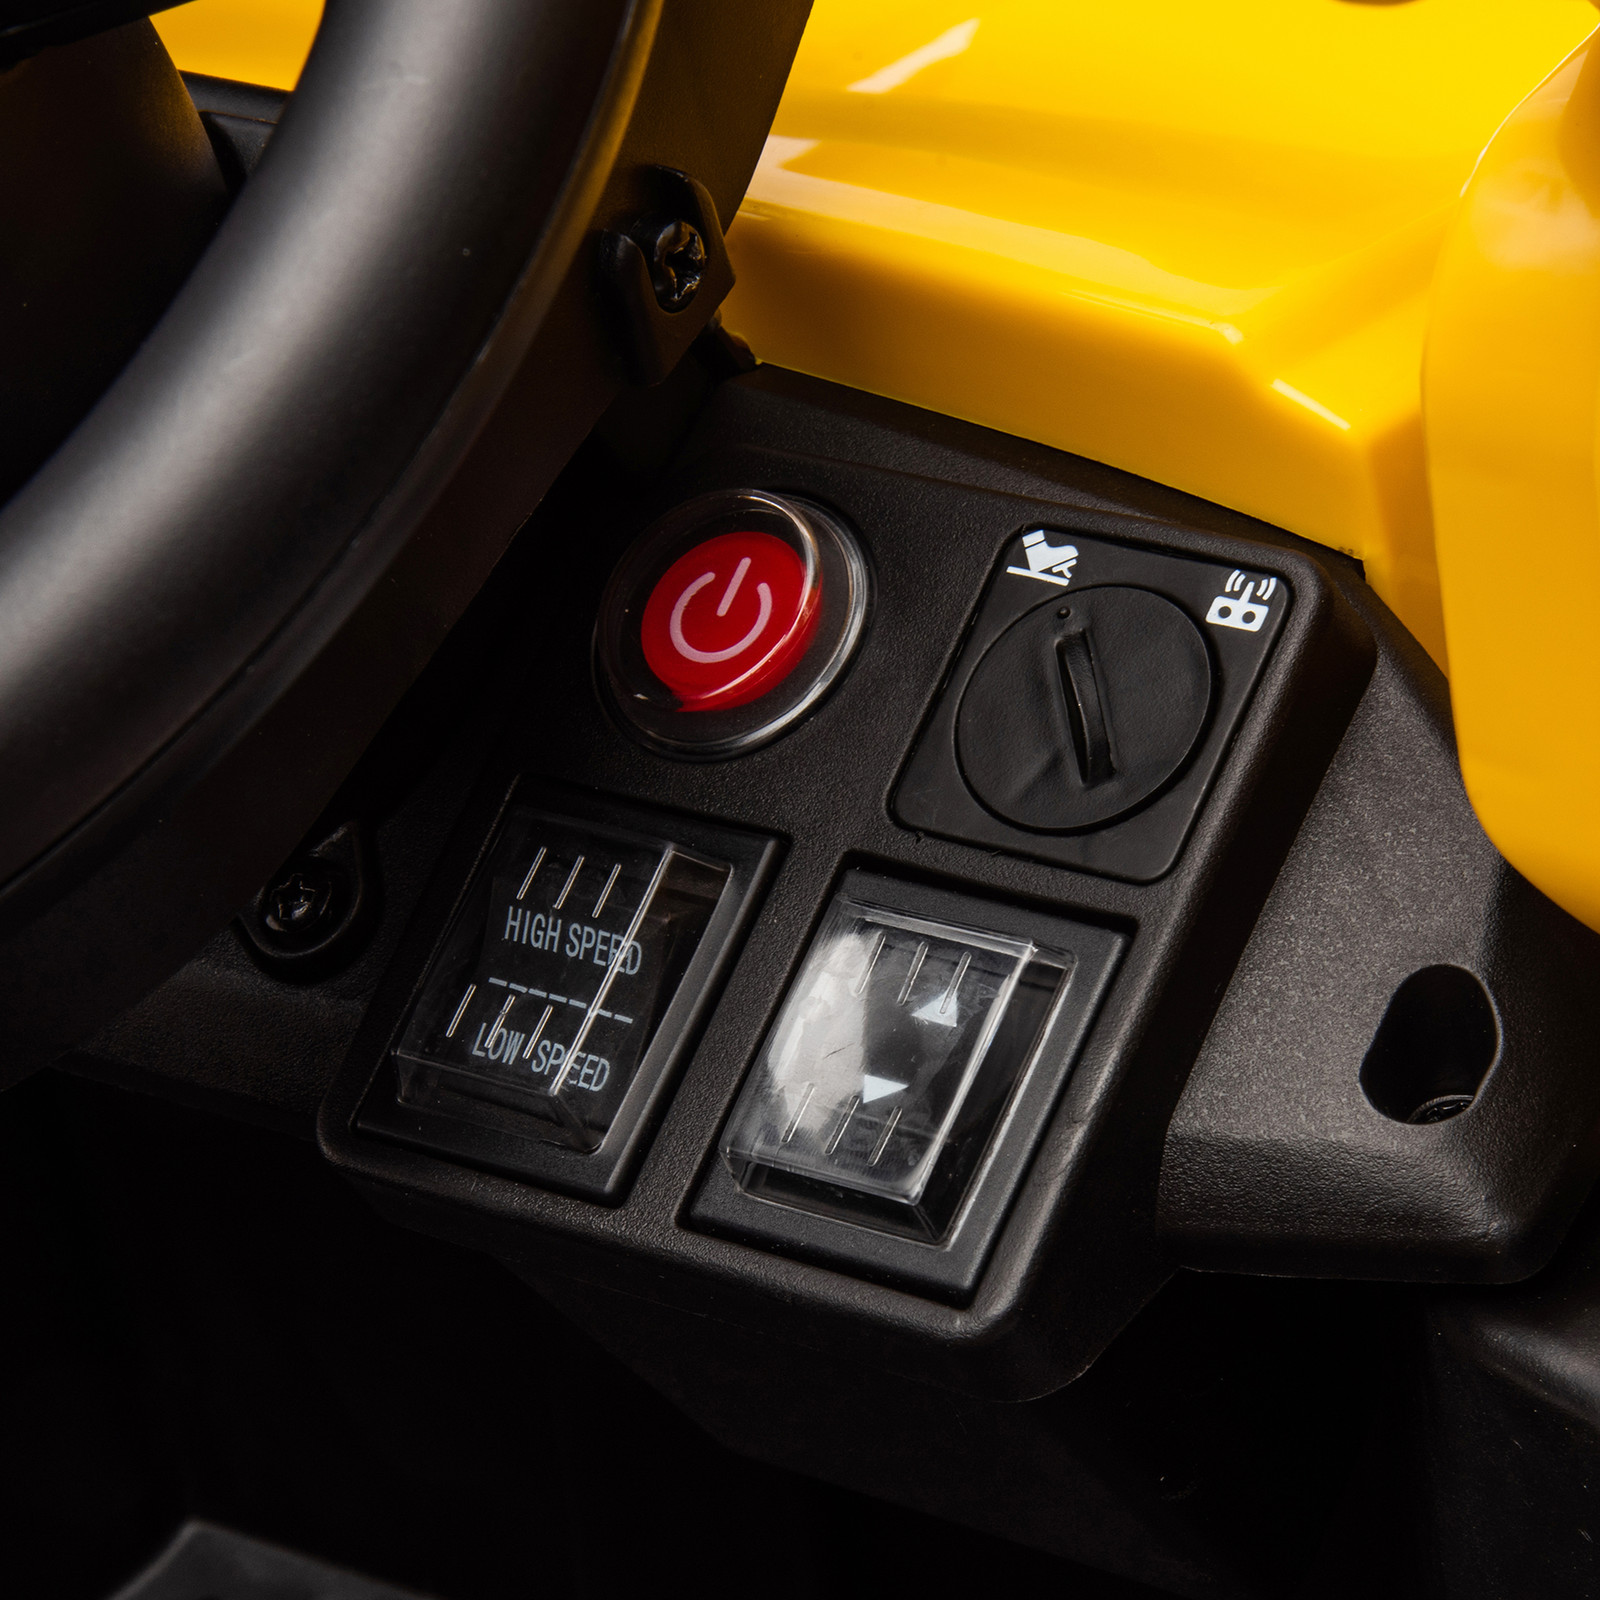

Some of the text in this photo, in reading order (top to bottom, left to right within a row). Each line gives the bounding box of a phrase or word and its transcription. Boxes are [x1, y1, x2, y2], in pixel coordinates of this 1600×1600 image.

[504, 905, 642, 975] HIGH SPEED
[472, 1022, 610, 1092] LOW SPEED
